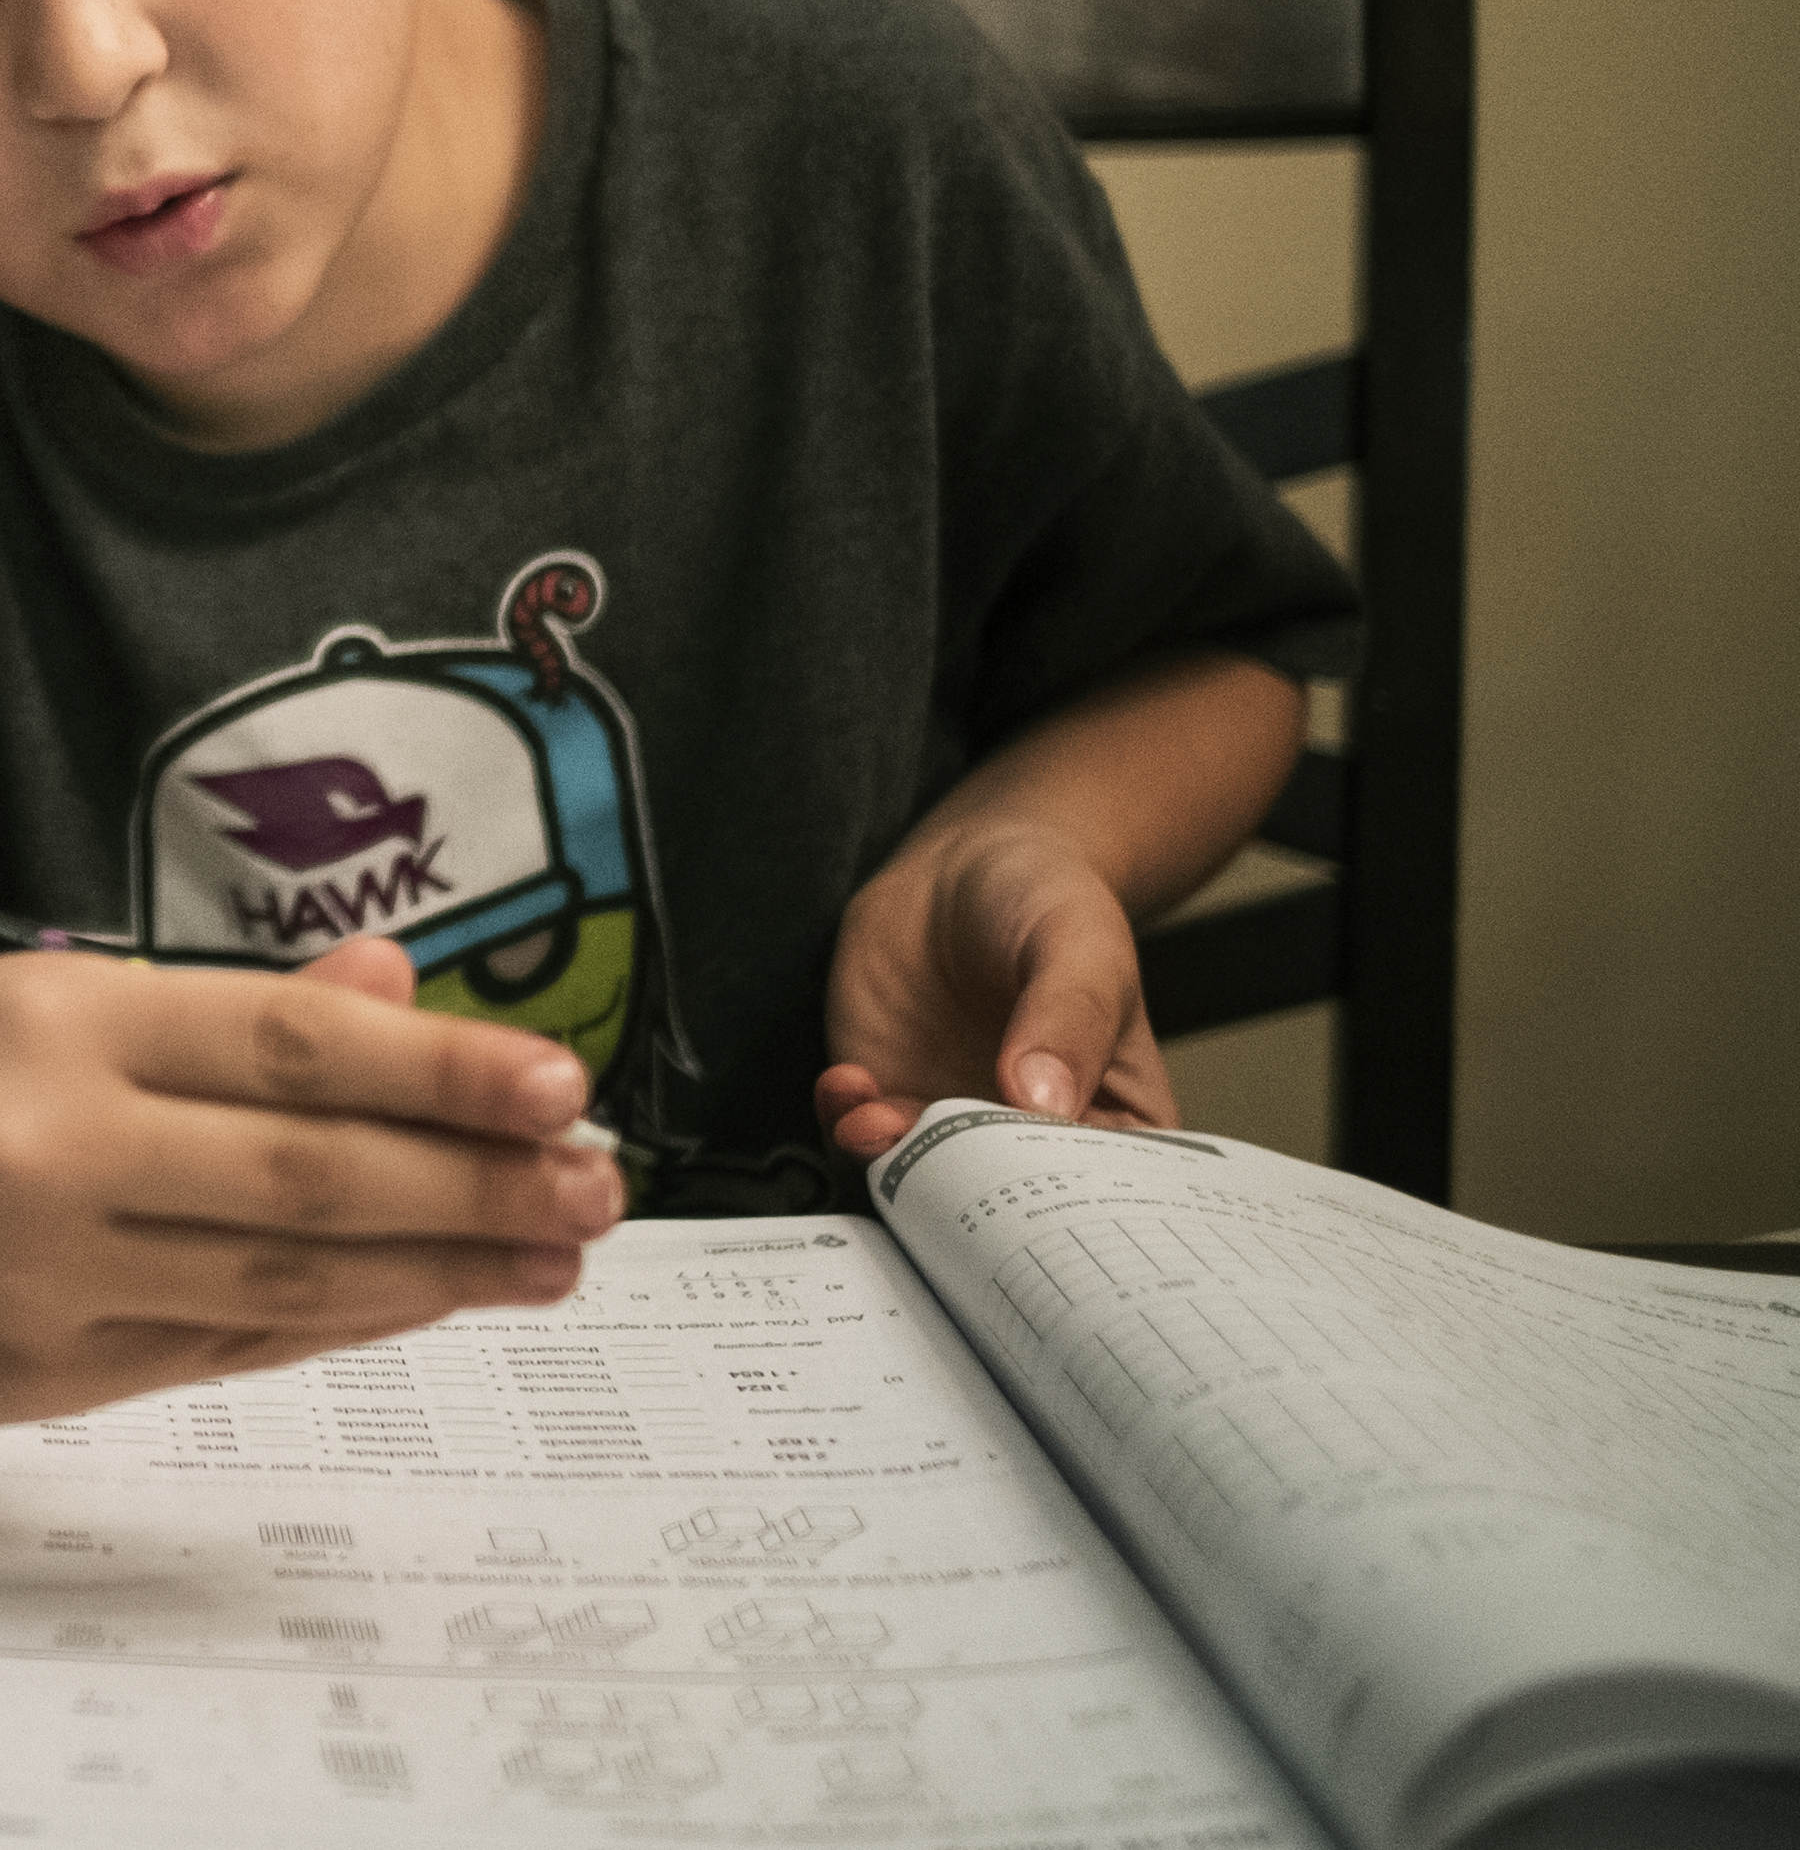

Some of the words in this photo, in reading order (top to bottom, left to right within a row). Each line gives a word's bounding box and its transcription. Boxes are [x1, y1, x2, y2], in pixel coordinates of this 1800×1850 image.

[230, 834, 452, 946] HAWK
[501, 1345, 600, 1353] thousands
[506, 1358, 606, 1366] thousands
[511, 1371, 612, 1379] thousands
[325, 1381, 416, 1391] hundreds
[516, 1384, 619, 1393] thousands
[332, 1405, 425, 1415] hundreds
[526, 1408, 631, 1417] thousands
[336, 1419, 430, 1429] hundreds
[532, 1422, 638, 1431] thousands
[340, 1433, 434, 1444] hundreds
[538, 1436, 644, 1446] thousands
[345, 1447, 440, 1458] hundreds
[545, 1451, 652, 1461] thousands
